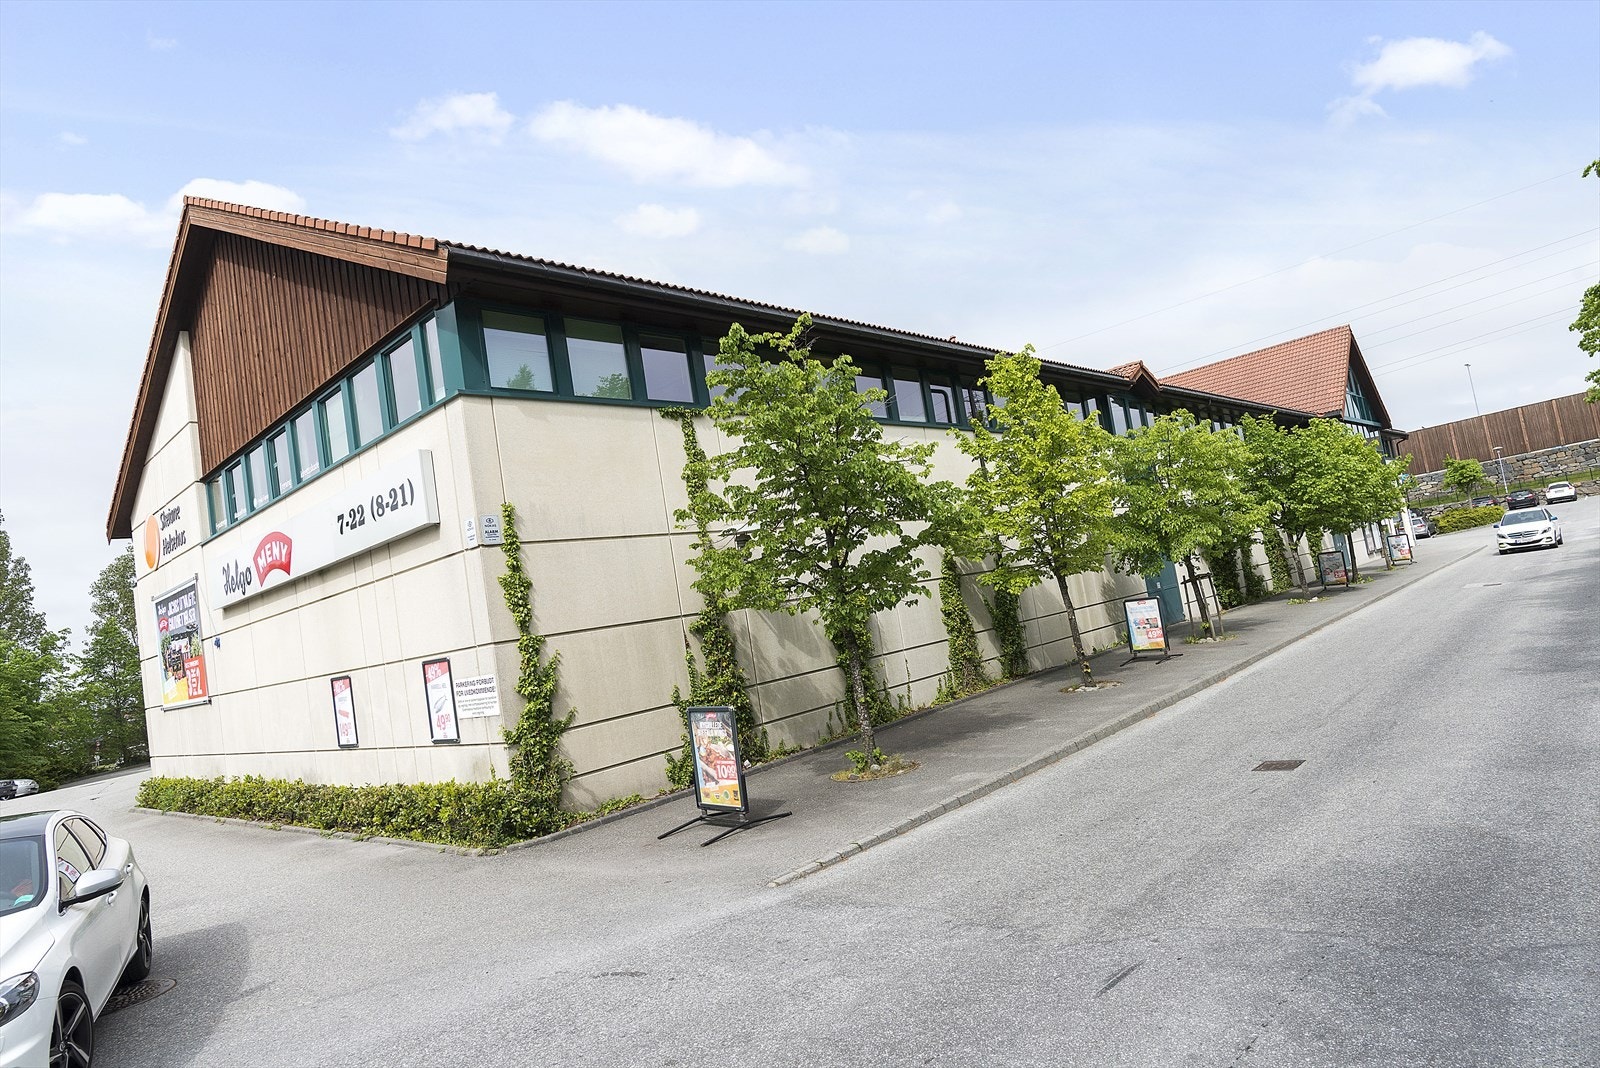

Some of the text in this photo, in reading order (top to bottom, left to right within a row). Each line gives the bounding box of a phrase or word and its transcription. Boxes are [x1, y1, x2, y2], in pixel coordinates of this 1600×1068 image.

[337, 477, 415, 536] 7-22 (8-21)
[256, 540, 289, 575] MENY
